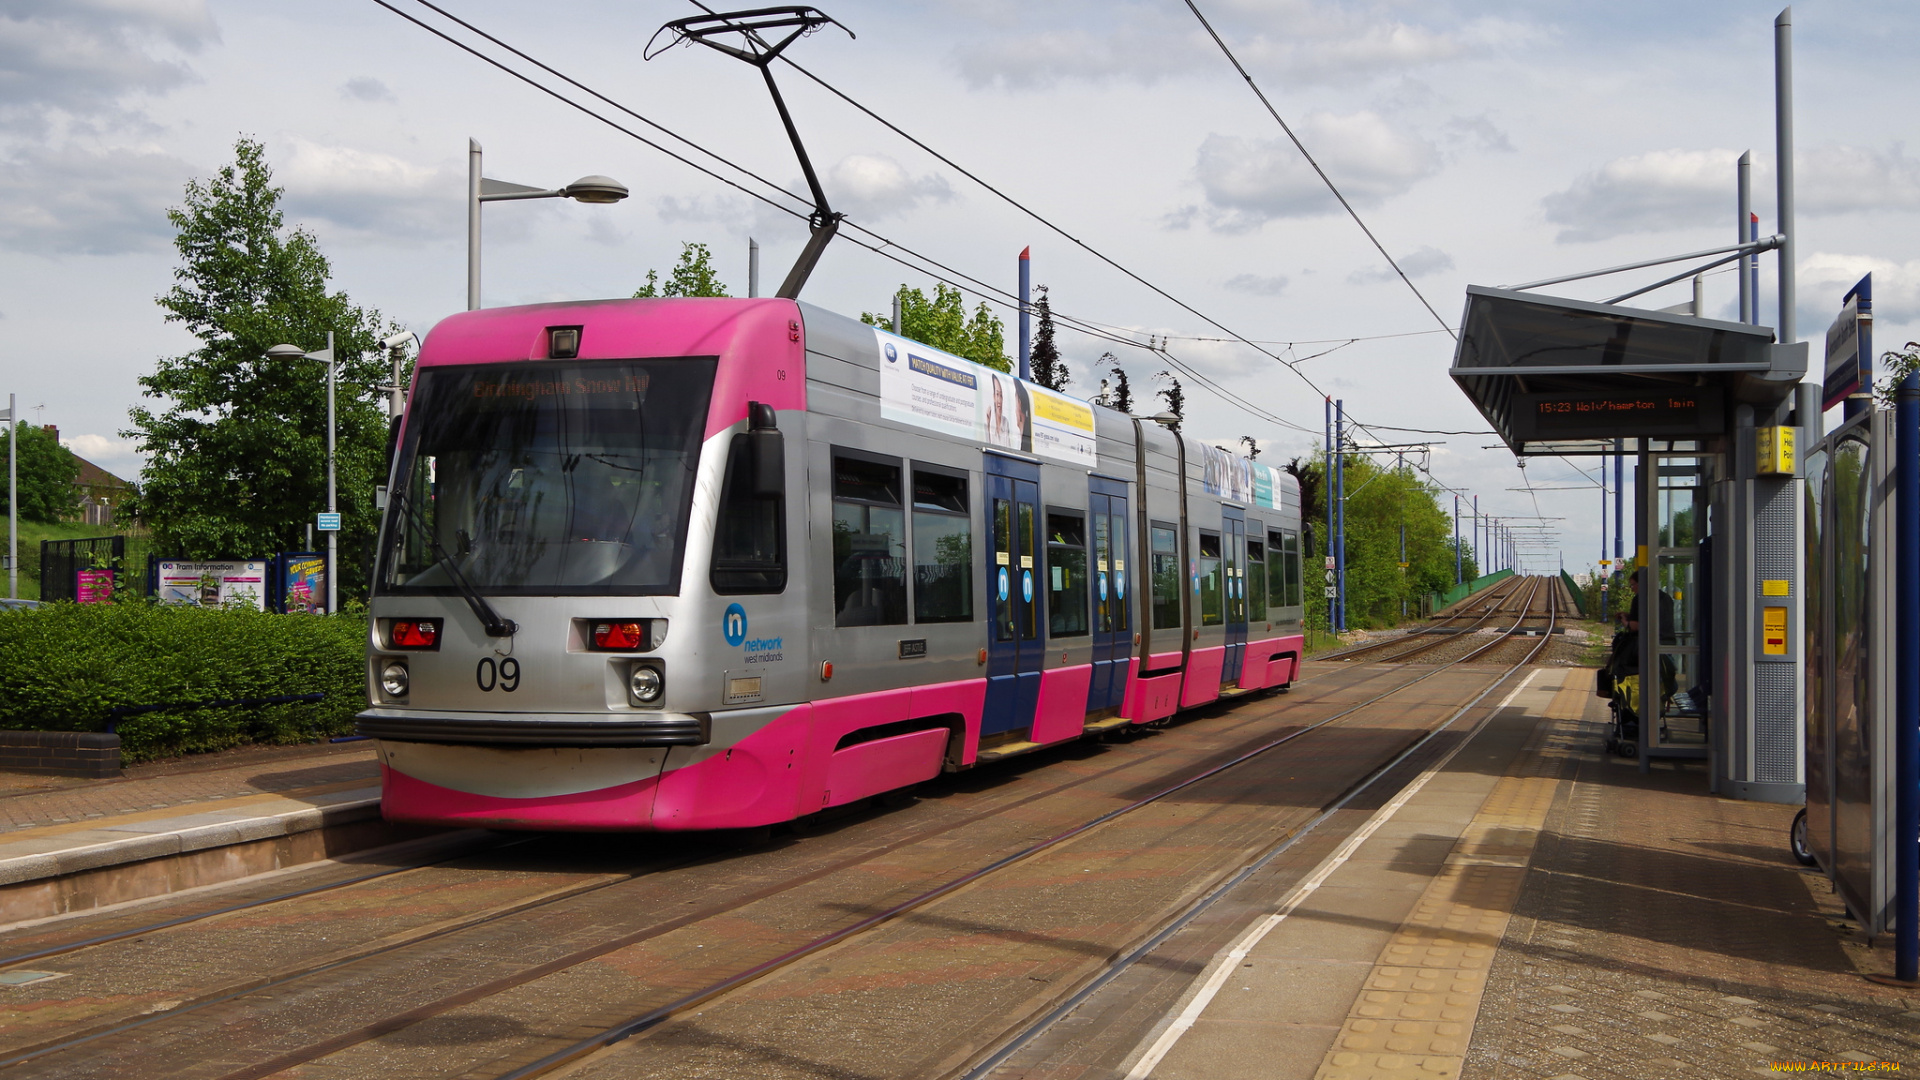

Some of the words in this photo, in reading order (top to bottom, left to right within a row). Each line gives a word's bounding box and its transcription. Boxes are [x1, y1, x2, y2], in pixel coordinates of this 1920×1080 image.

[777, 369, 786, 381] 09
[926, 362, 942, 376] QUALITY
[473, 380, 571, 401] Birmingham
[575, 377, 620, 394] Snow
[625, 375, 650, 392] Hill
[1539, 402, 1571, 413] 15:23
[1576, 400, 1655, 412] Wolv'hampton
[1668, 398, 1695, 409] 1min
[194, 563, 234, 571] Information
[728, 613, 742, 637] n
[744, 636, 783, 652] network
[744, 653, 757, 664] west
[758, 651, 783, 663] midlands
[476, 656, 521, 693] 09
